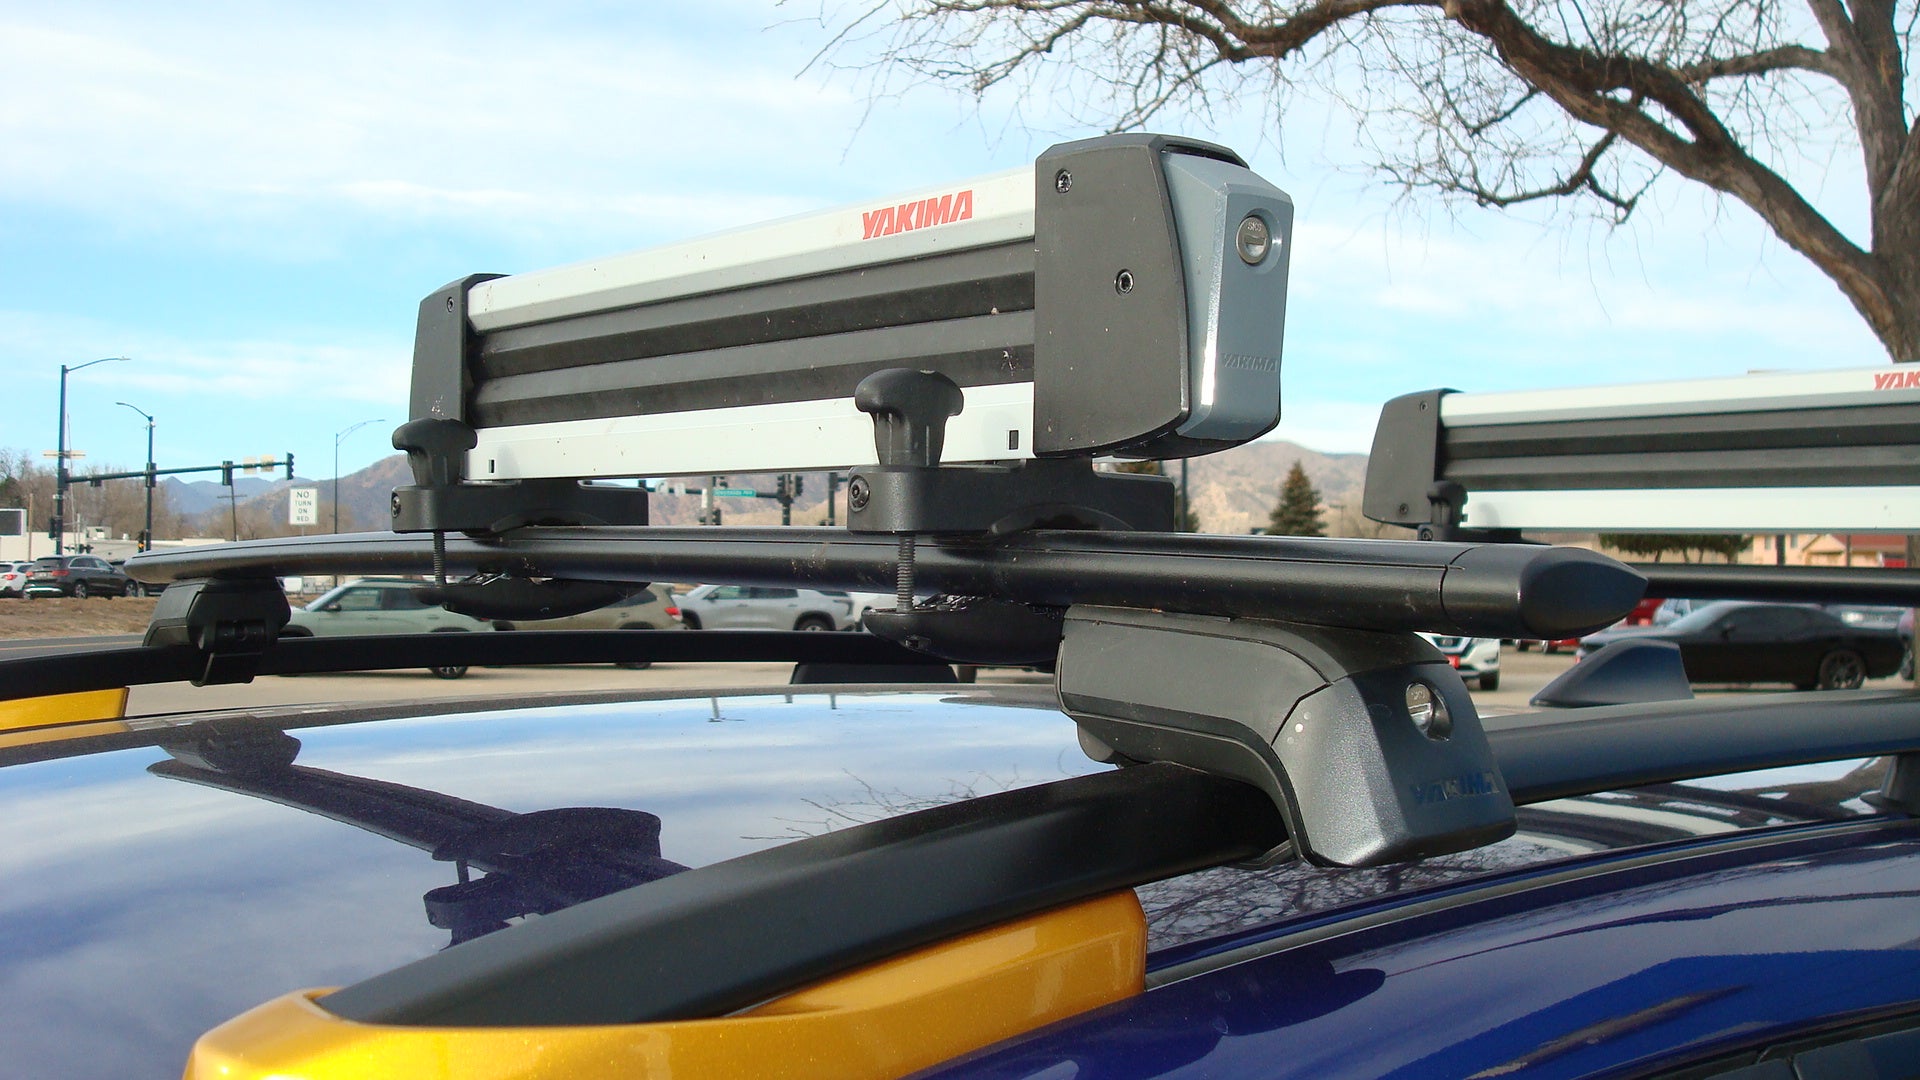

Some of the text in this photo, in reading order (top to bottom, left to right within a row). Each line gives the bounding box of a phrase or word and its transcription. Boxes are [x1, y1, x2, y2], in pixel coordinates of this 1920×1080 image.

[862, 190, 973, 240] YAKIMA
[296, 491, 310, 499] NO
[1411, 770, 1500, 802] YAKIMA
